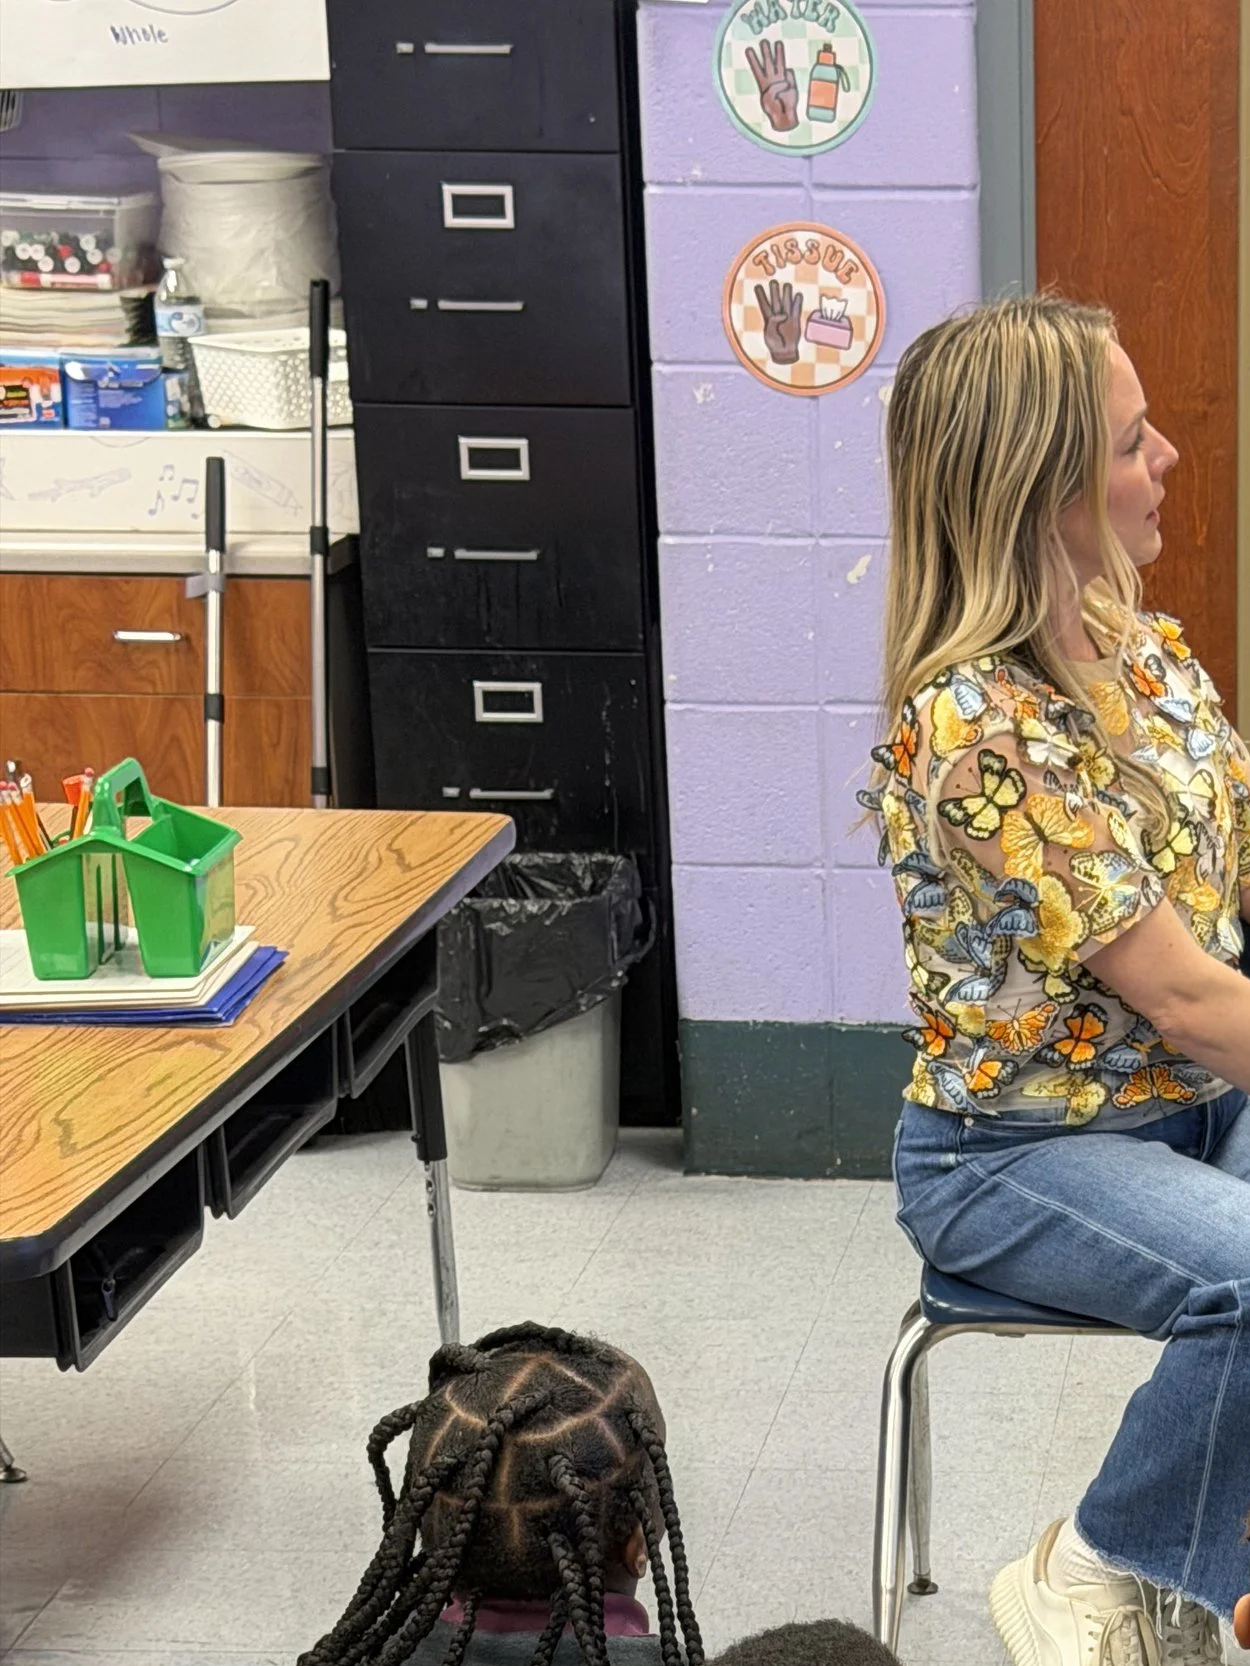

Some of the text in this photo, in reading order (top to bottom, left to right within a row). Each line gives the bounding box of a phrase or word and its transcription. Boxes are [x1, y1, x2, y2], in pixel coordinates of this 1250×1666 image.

[109, 24, 168, 45] Whole
[740, 0, 840, 36] WATER
[752, 238, 859, 285] TISSUE
